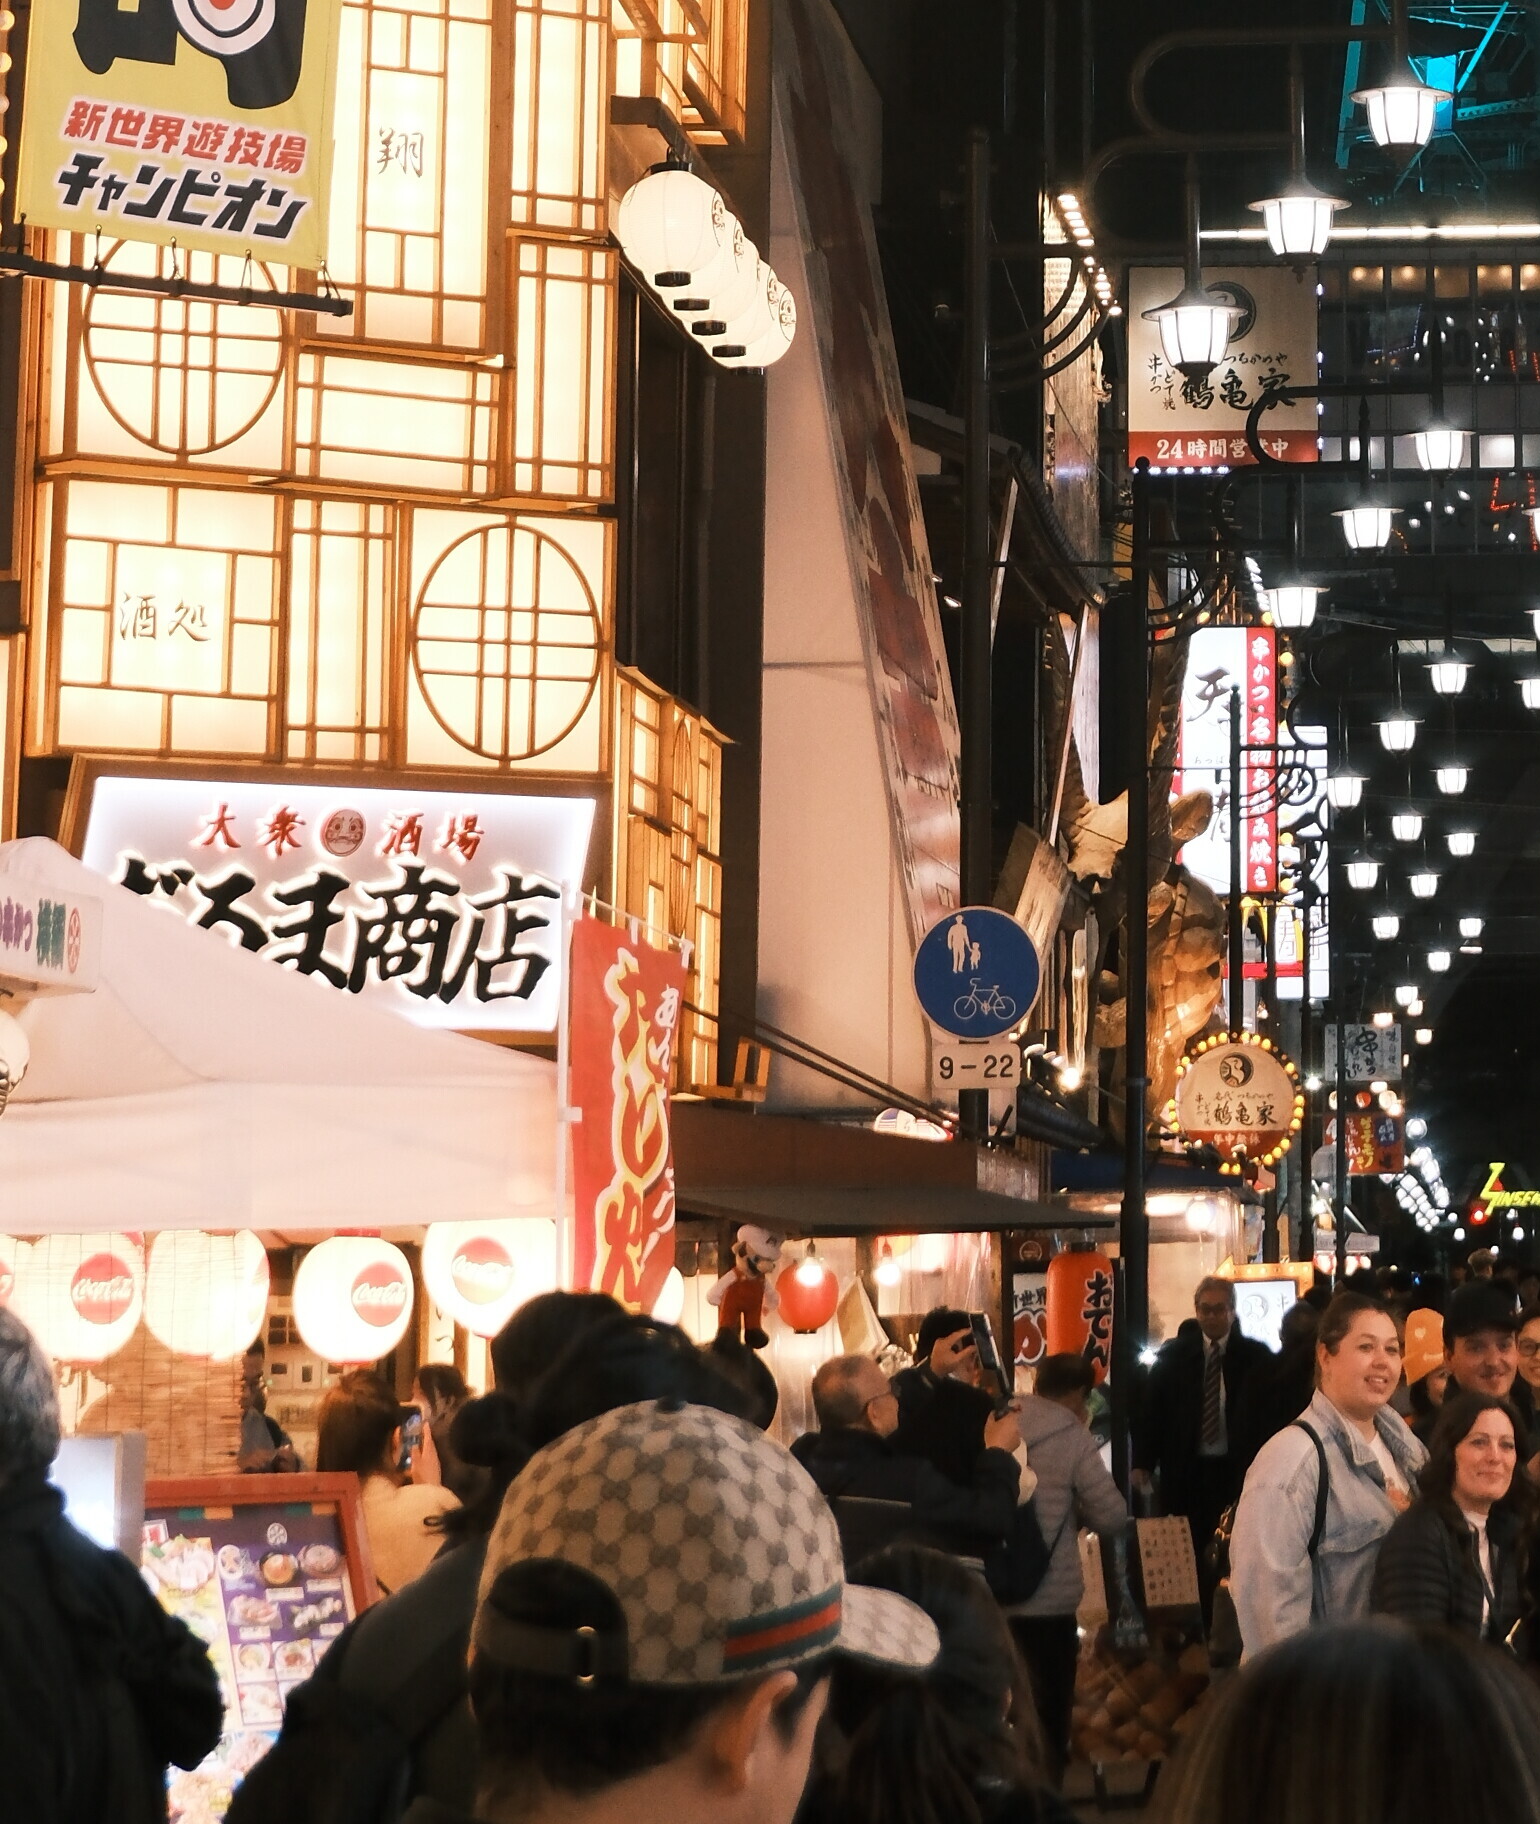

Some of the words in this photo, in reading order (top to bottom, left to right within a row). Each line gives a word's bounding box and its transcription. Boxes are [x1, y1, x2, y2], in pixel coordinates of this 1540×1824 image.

[63, 99, 308, 175] 新世界遊技場
[56, 152, 311, 240] チャンピオン
[1156, 438, 1289, 460] 24時間営中
[118, 590, 213, 643] 酒処
[939, 1054, 1014, 1080] 9-22
